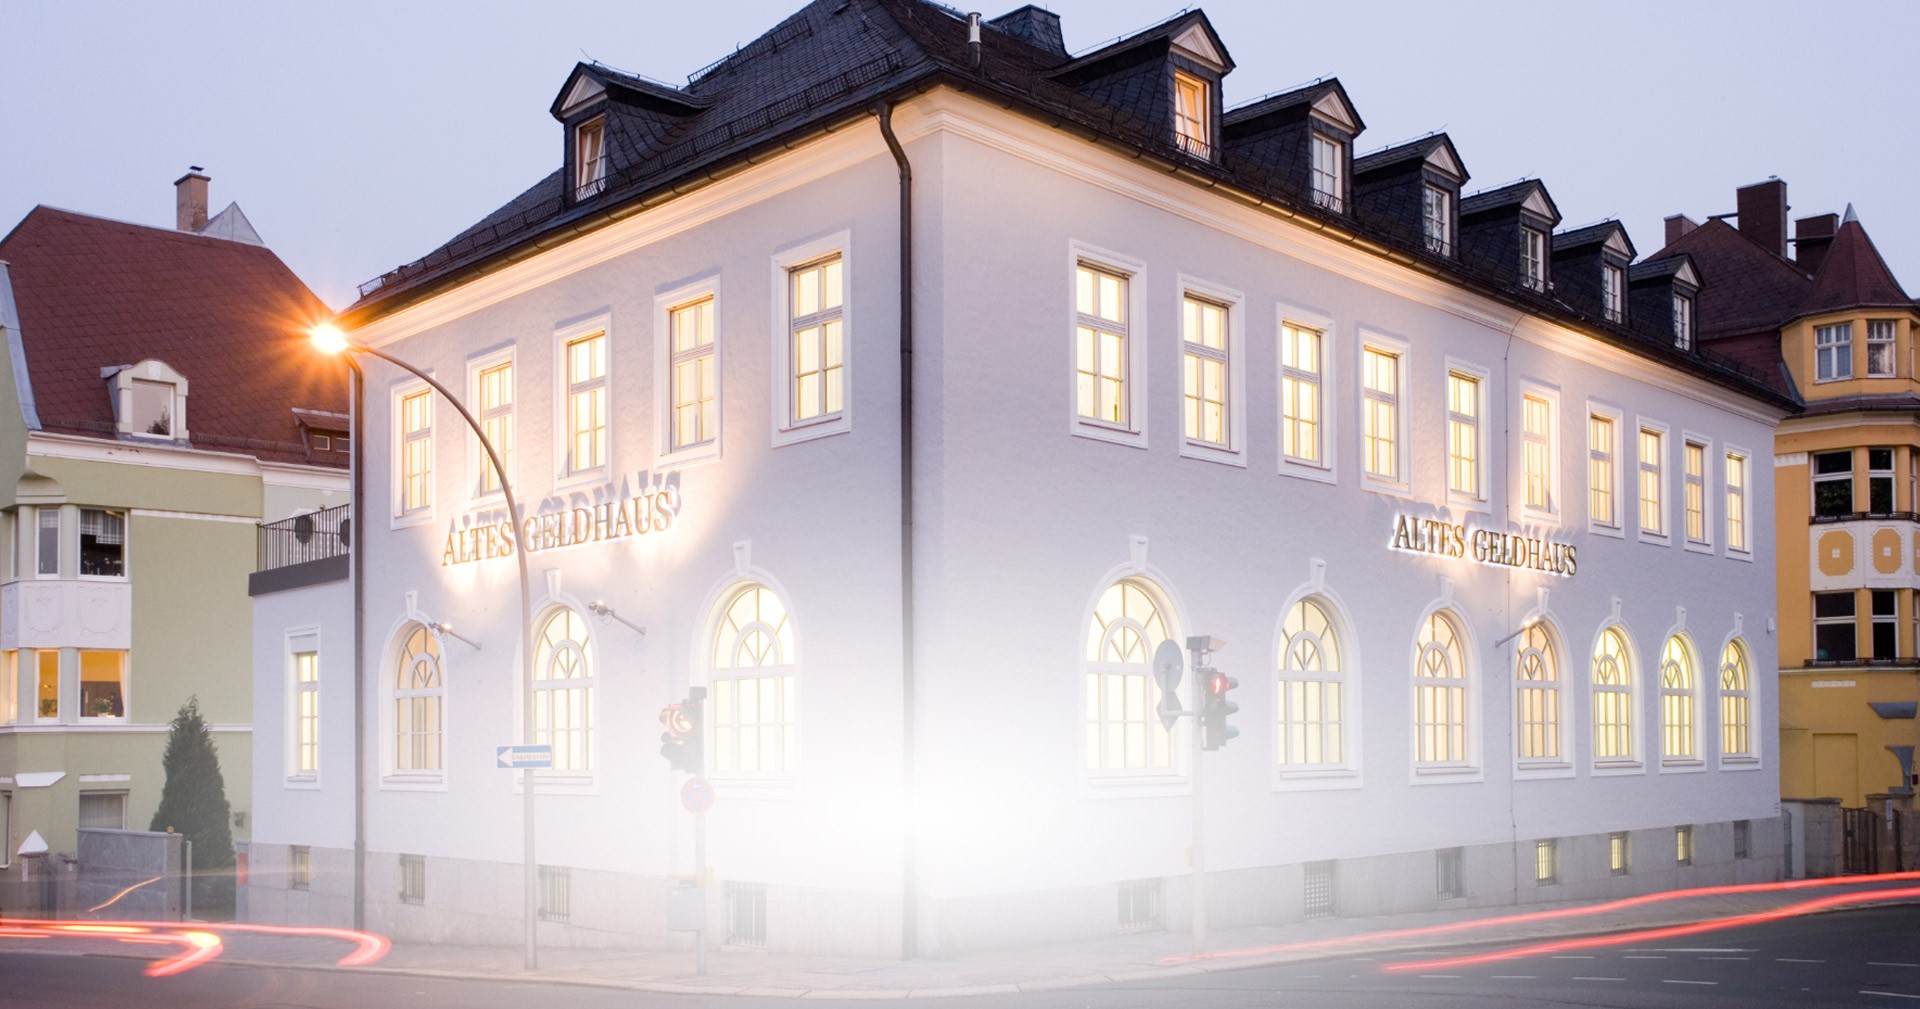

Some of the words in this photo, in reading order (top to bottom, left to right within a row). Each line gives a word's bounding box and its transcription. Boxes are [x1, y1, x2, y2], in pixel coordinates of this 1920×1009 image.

[442, 521, 515, 566] ALTES
[523, 491, 672, 552] GELDHAUS
[1393, 514, 1465, 559] ALTES
[1471, 529, 1577, 576] GELDHAUS
